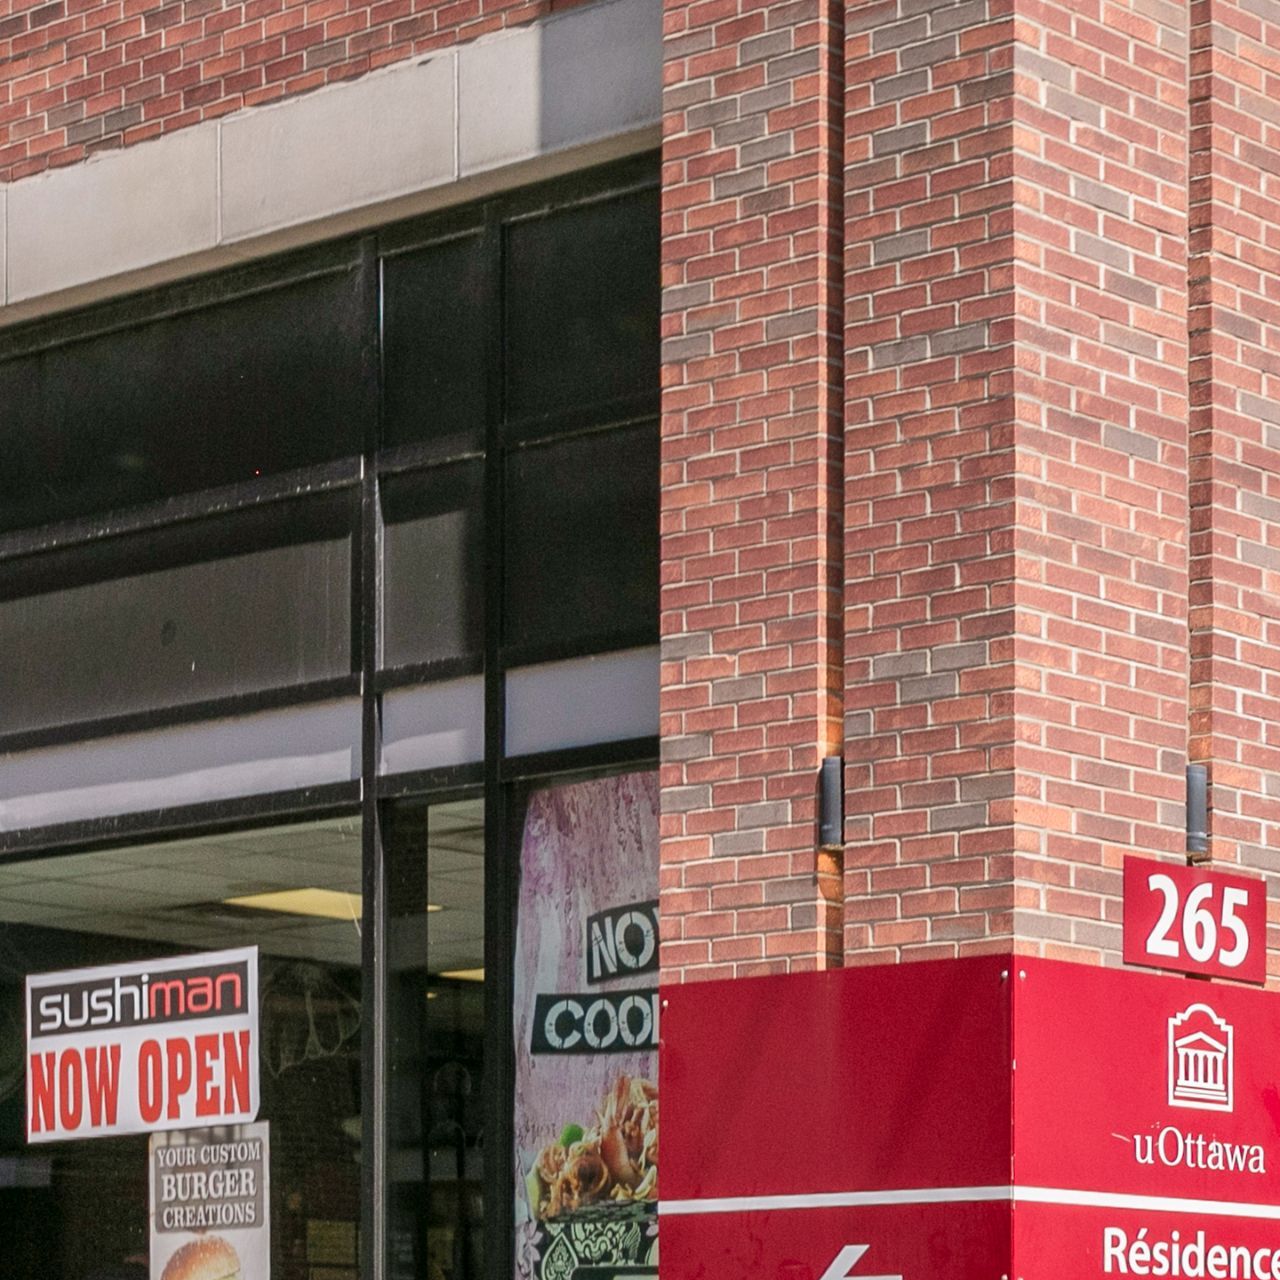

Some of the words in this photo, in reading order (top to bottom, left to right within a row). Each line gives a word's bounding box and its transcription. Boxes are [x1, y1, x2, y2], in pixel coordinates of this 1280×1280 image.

[592, 906, 660, 979] NO
[1145, 873, 1250, 968] 265
[39, 972, 242, 1031] sushiman
[30, 1043, 121, 1134] NOW
[138, 1029, 251, 1125] OPEN
[157, 1146, 197, 1168] YOUR
[200, 1141, 261, 1164] CUSTOM
[1133, 1126, 1266, 1174] uOttawa
[161, 1168, 257, 1202] BURGER
[163, 1201, 256, 1229] CREATIONS
